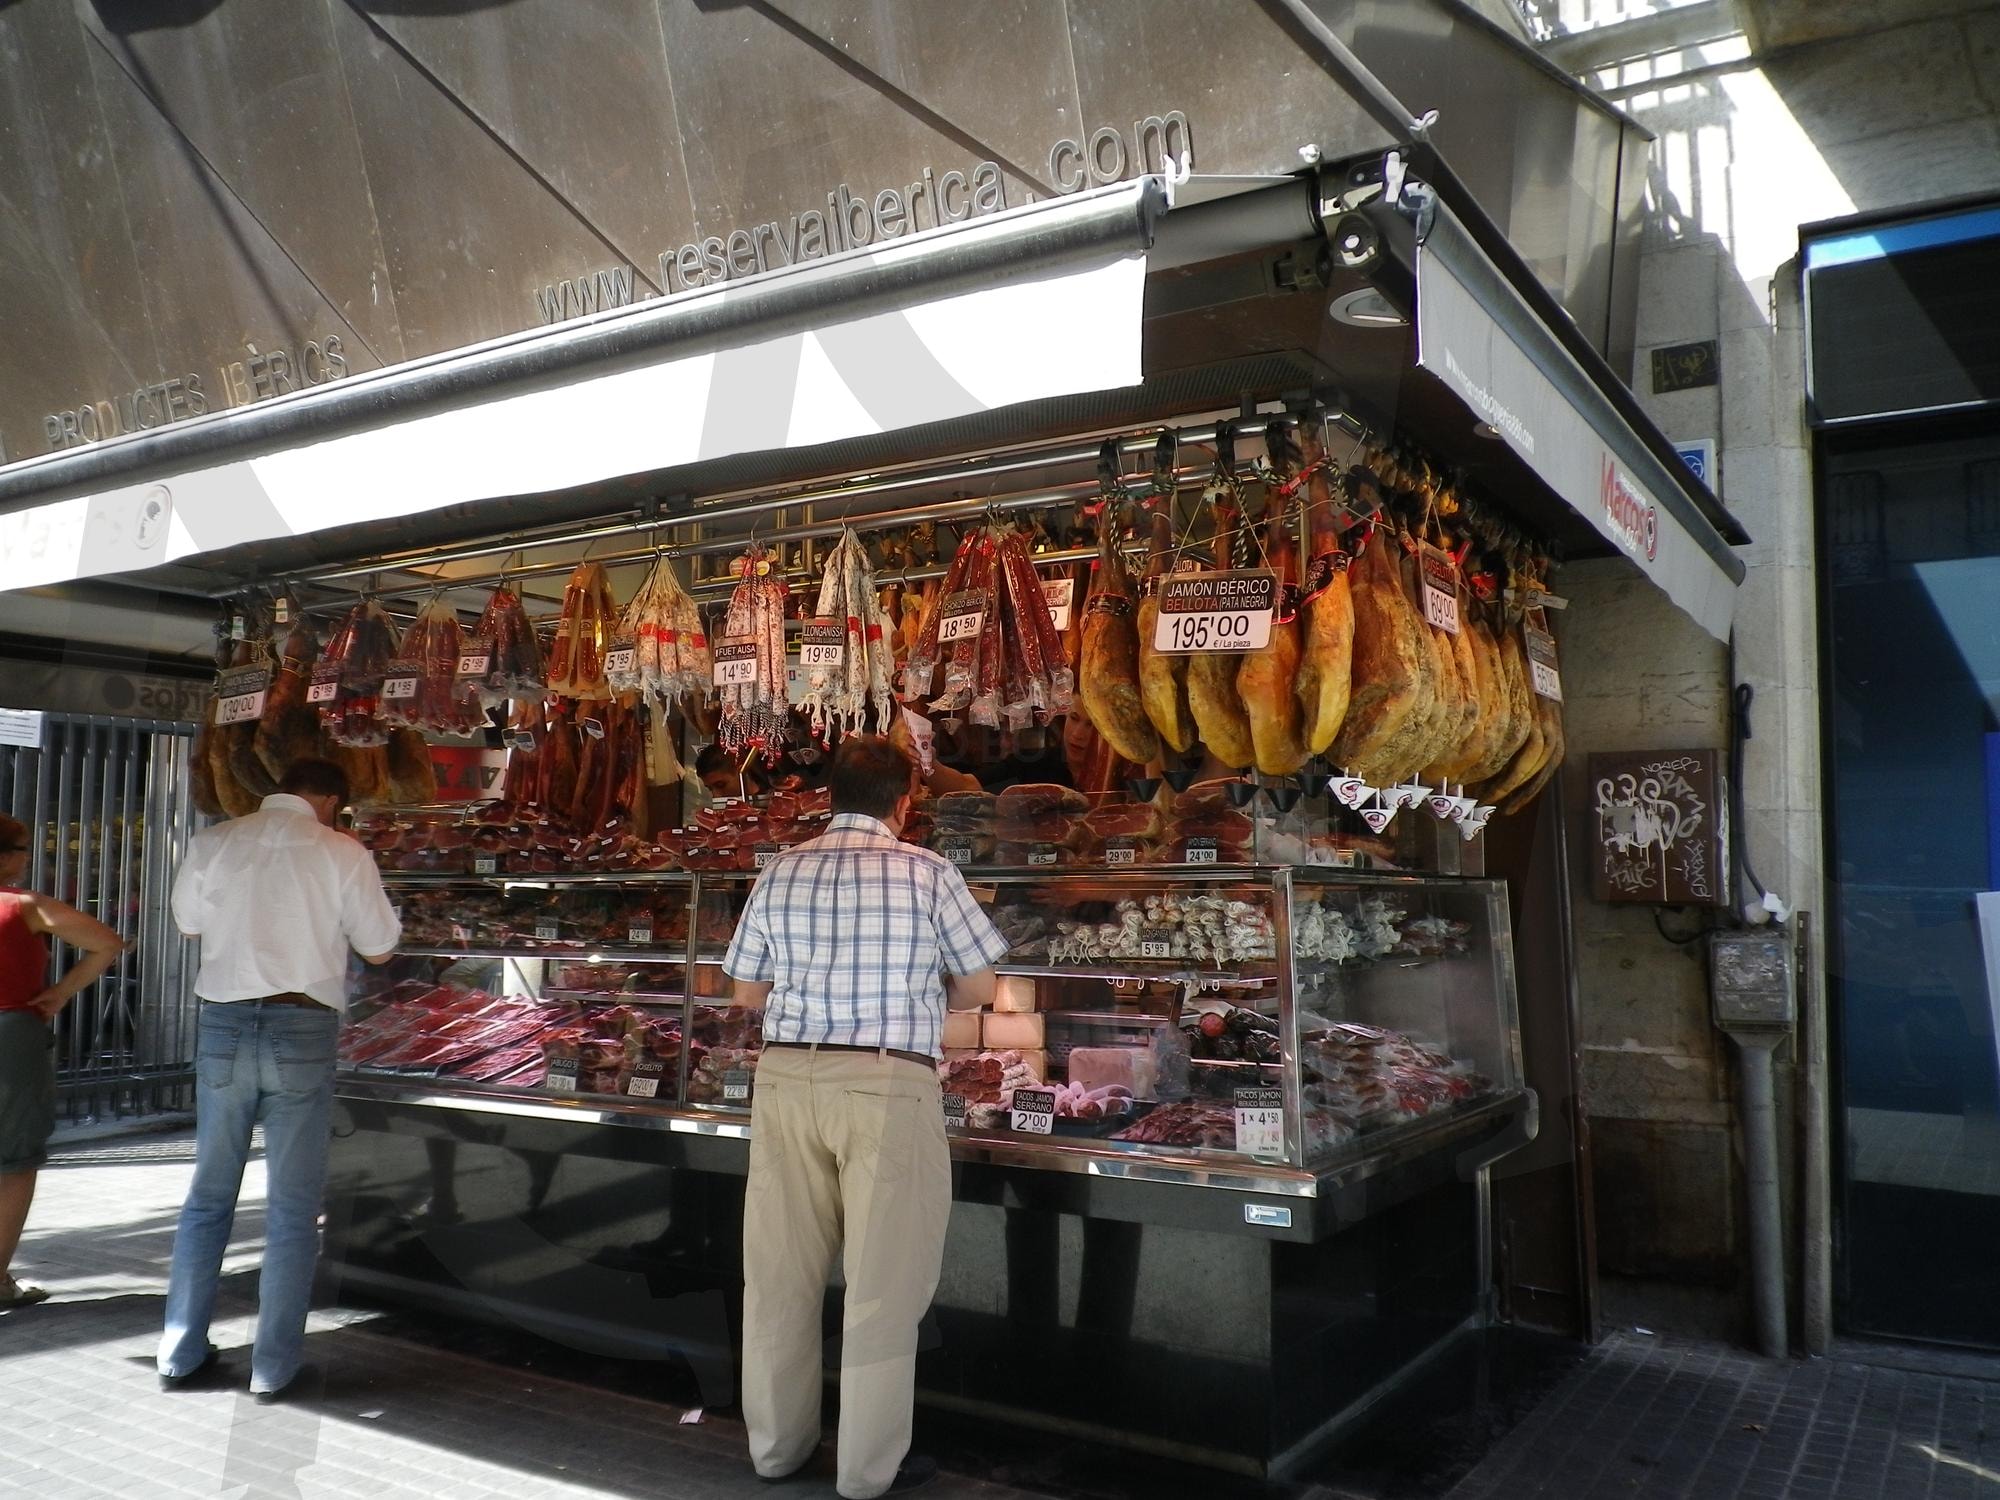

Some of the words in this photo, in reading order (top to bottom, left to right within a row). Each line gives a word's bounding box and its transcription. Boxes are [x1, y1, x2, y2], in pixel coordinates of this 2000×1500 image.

[43, 372, 209, 450] PRODUCTES
[1167, 579, 1213, 598] JAMÓN
[1215, 577, 1270, 596] IBÉRICO
[1166, 597, 1218, 611] BELLOTA
[1219, 597, 1240, 610] (PATA
[1240, 594, 1268, 609] NEGRA)
[1431, 591, 1454, 624] 69'00
[943, 616, 976, 638] 18'50
[1172, 615, 1250, 649] 195'00
[718, 646, 736, 657] FUET
[737, 644, 756, 655] AUSA
[1233, 640, 1251, 649] pieza
[607, 652, 630, 671] 5'95
[806, 646, 838, 663] 19'80
[461, 656, 484, 671] 6'95
[722, 662, 752, 681] 14'90
[312, 684, 333, 700] 6'95
[386, 681, 412, 696] 4'95
[1108, 851, 1132, 862] 29'00
[1189, 851, 1214, 862] 24'00
[1145, 943, 1165, 955] 5'95
[635, 1062, 663, 1072] JOSELITO
[1015, 1091, 1034, 1101] TACOS
[1236, 1090, 1258, 1099] TACOS
[1259, 1091, 1281, 1100] JAMON
[1015, 1101, 1052, 1113] SERRANO
[1016, 1112, 1048, 1130] 2'00
[1241, 1112, 1246, 1125] 1
[1258, 1112, 1279, 1125] 4'50
